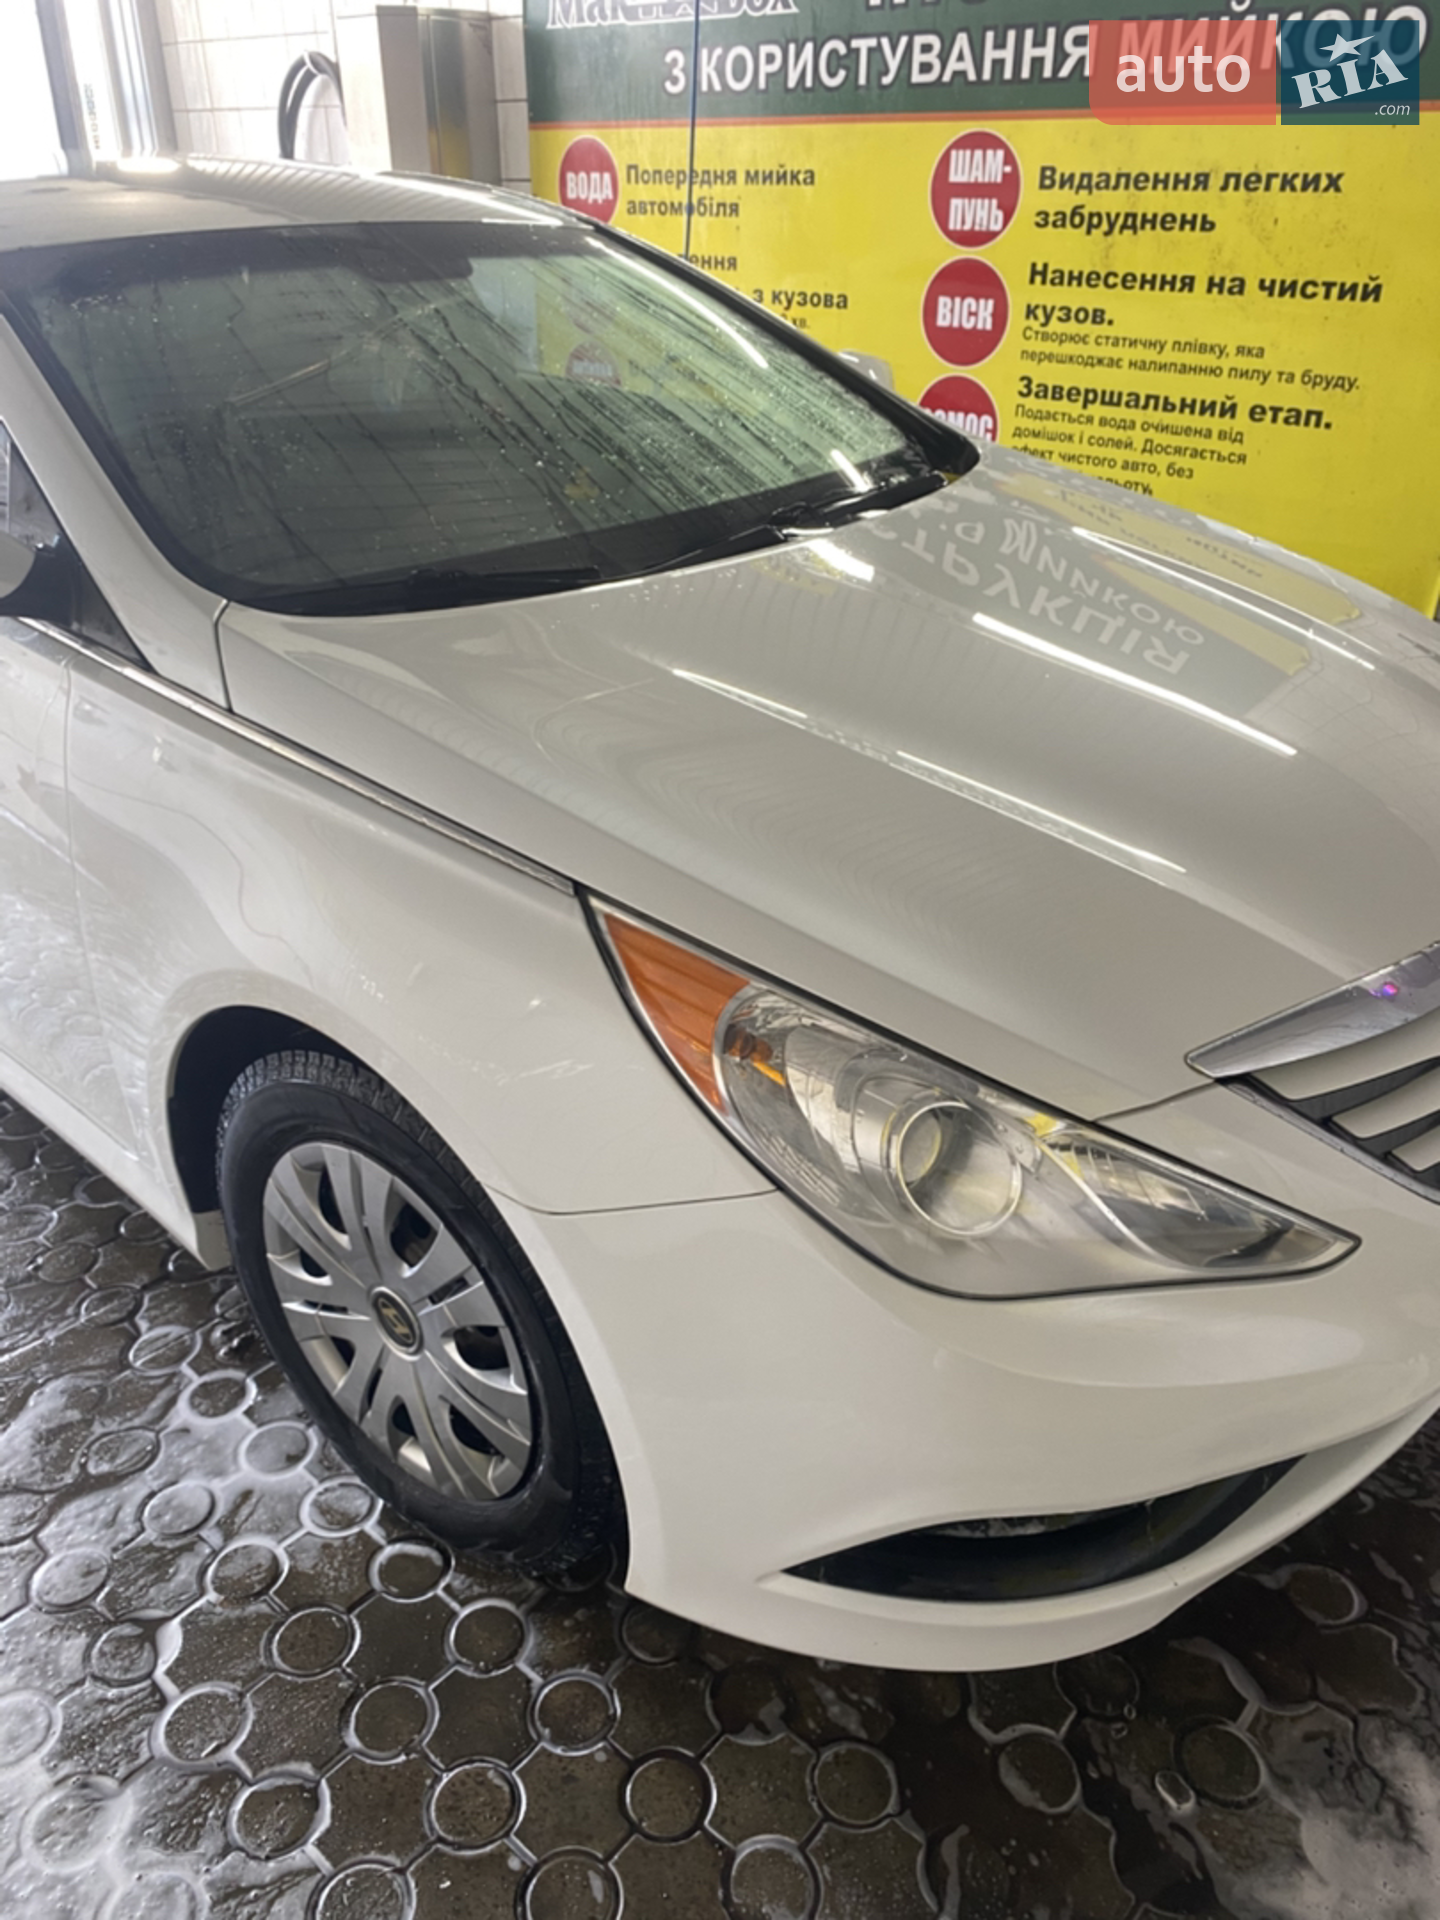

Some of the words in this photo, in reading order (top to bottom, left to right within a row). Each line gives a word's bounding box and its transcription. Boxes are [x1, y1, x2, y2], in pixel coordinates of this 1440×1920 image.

[700, 24, 1098, 92] КОРИСТУВАННЯ
[626, 164, 738, 190] Попередня
[744, 164, 816, 187] мийка
[948, 149, 1012, 184] ШАМ-
[1038, 165, 1210, 195] Видалення
[1219, 171, 1345, 193] легких
[566, 171, 614, 204] ВОДА
[948, 197, 1004, 232] ПУНЬ
[1034, 204, 1217, 237] забруднень
[771, 289, 849, 311] кузова
[1028, 262, 1196, 294] Нанесення
[1206, 275, 1246, 296] на
[1258, 275, 1383, 303] чистий
[936, 296, 994, 331] ВІСК
[1024, 303, 1115, 327] кузов.
[1022, 326, 1090, 346] Створює
[1094, 335, 1168, 355] статичну
[1171, 339, 1230, 359] плівку,
[1235, 347, 1265, 360] яка
[1020, 349, 1124, 370] перешкоджає
[1127, 359, 1224, 379] налипанню
[1228, 367, 1272, 386] пилу
[1276, 370, 1296, 385] та
[1300, 369, 1361, 394] бруду.
[1017, 375, 1238, 420] Завершальний
[1248, 403, 1333, 430] етап.
[1014, 404, 1094, 426] Подається
[1098, 416, 1136, 431] вода
[1217, 426, 1245, 446] від
[1011, 426, 1075, 444] домішок
[1078, 430, 1084, 445] і
[1087, 434, 1137, 451] солей.
[1140, 438, 1248, 466] Досягається
[1057, 450, 1117, 470] чистого
[1120, 458, 1161, 477] авто,
[1165, 461, 1195, 480] без
